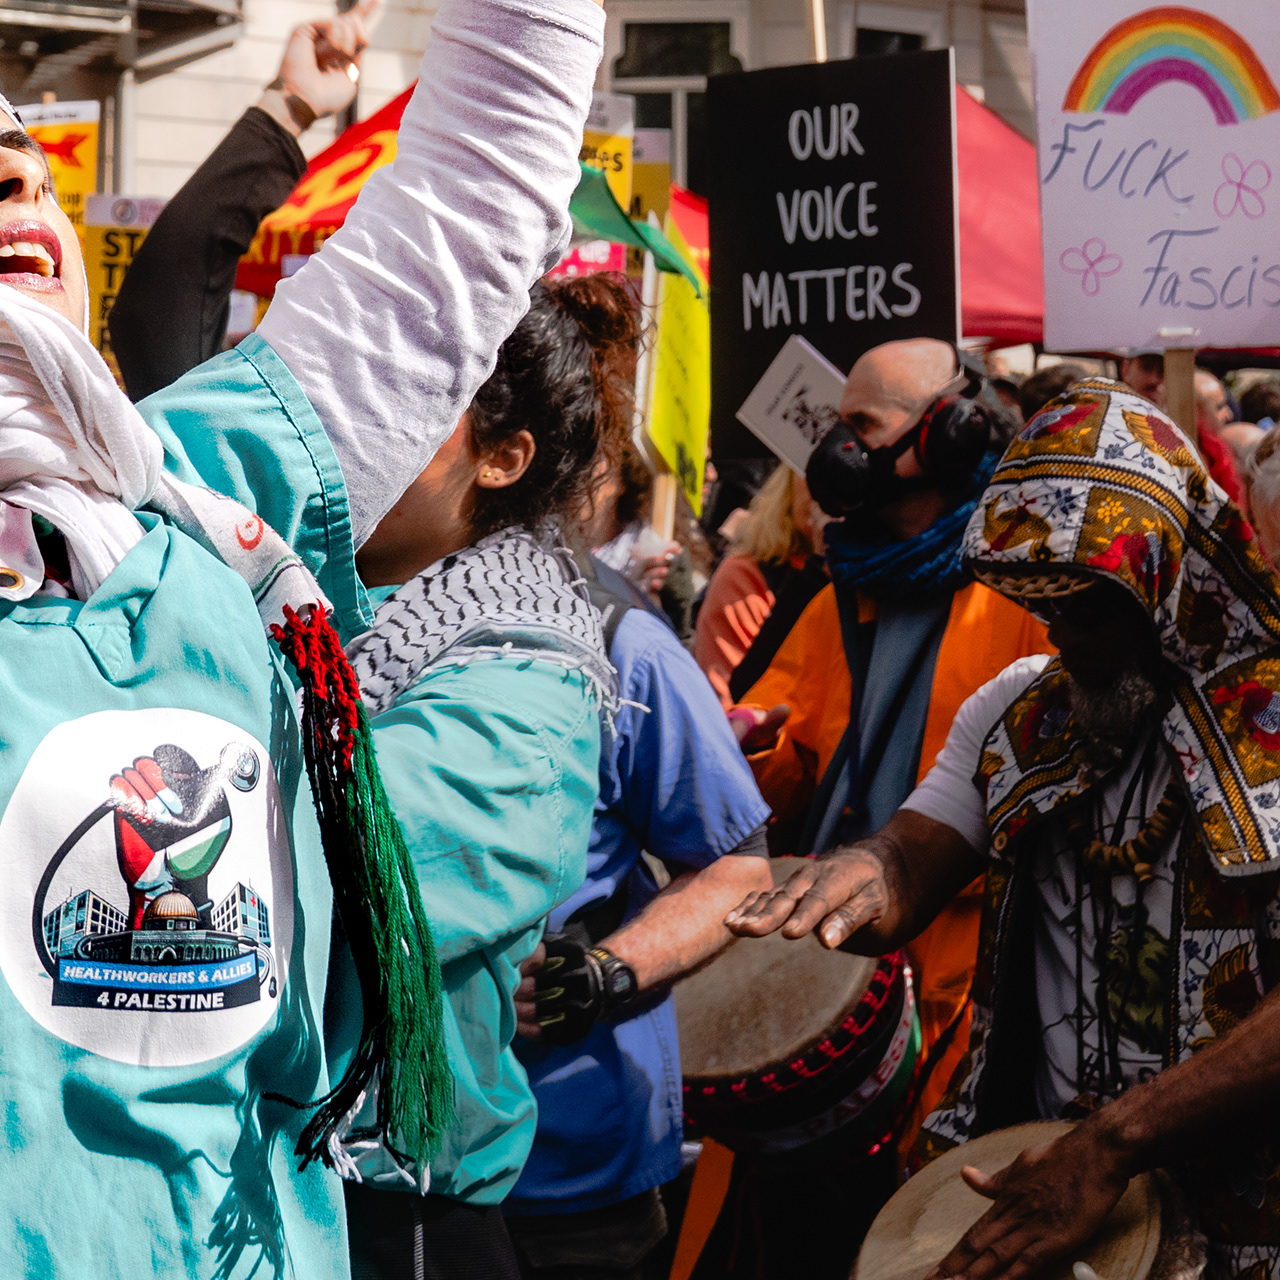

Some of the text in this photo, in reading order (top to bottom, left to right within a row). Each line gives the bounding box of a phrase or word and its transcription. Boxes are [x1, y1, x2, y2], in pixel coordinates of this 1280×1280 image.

[787, 101, 866, 161] OUR
[1042, 119, 1195, 204] FUCK
[776, 180, 879, 244] VOICE
[742, 262, 922, 331] MATTERS
[62, 961, 252, 985] HEALTHWORKERS & ALLIES
[96, 991, 224, 1009] 4 PALESTINE
